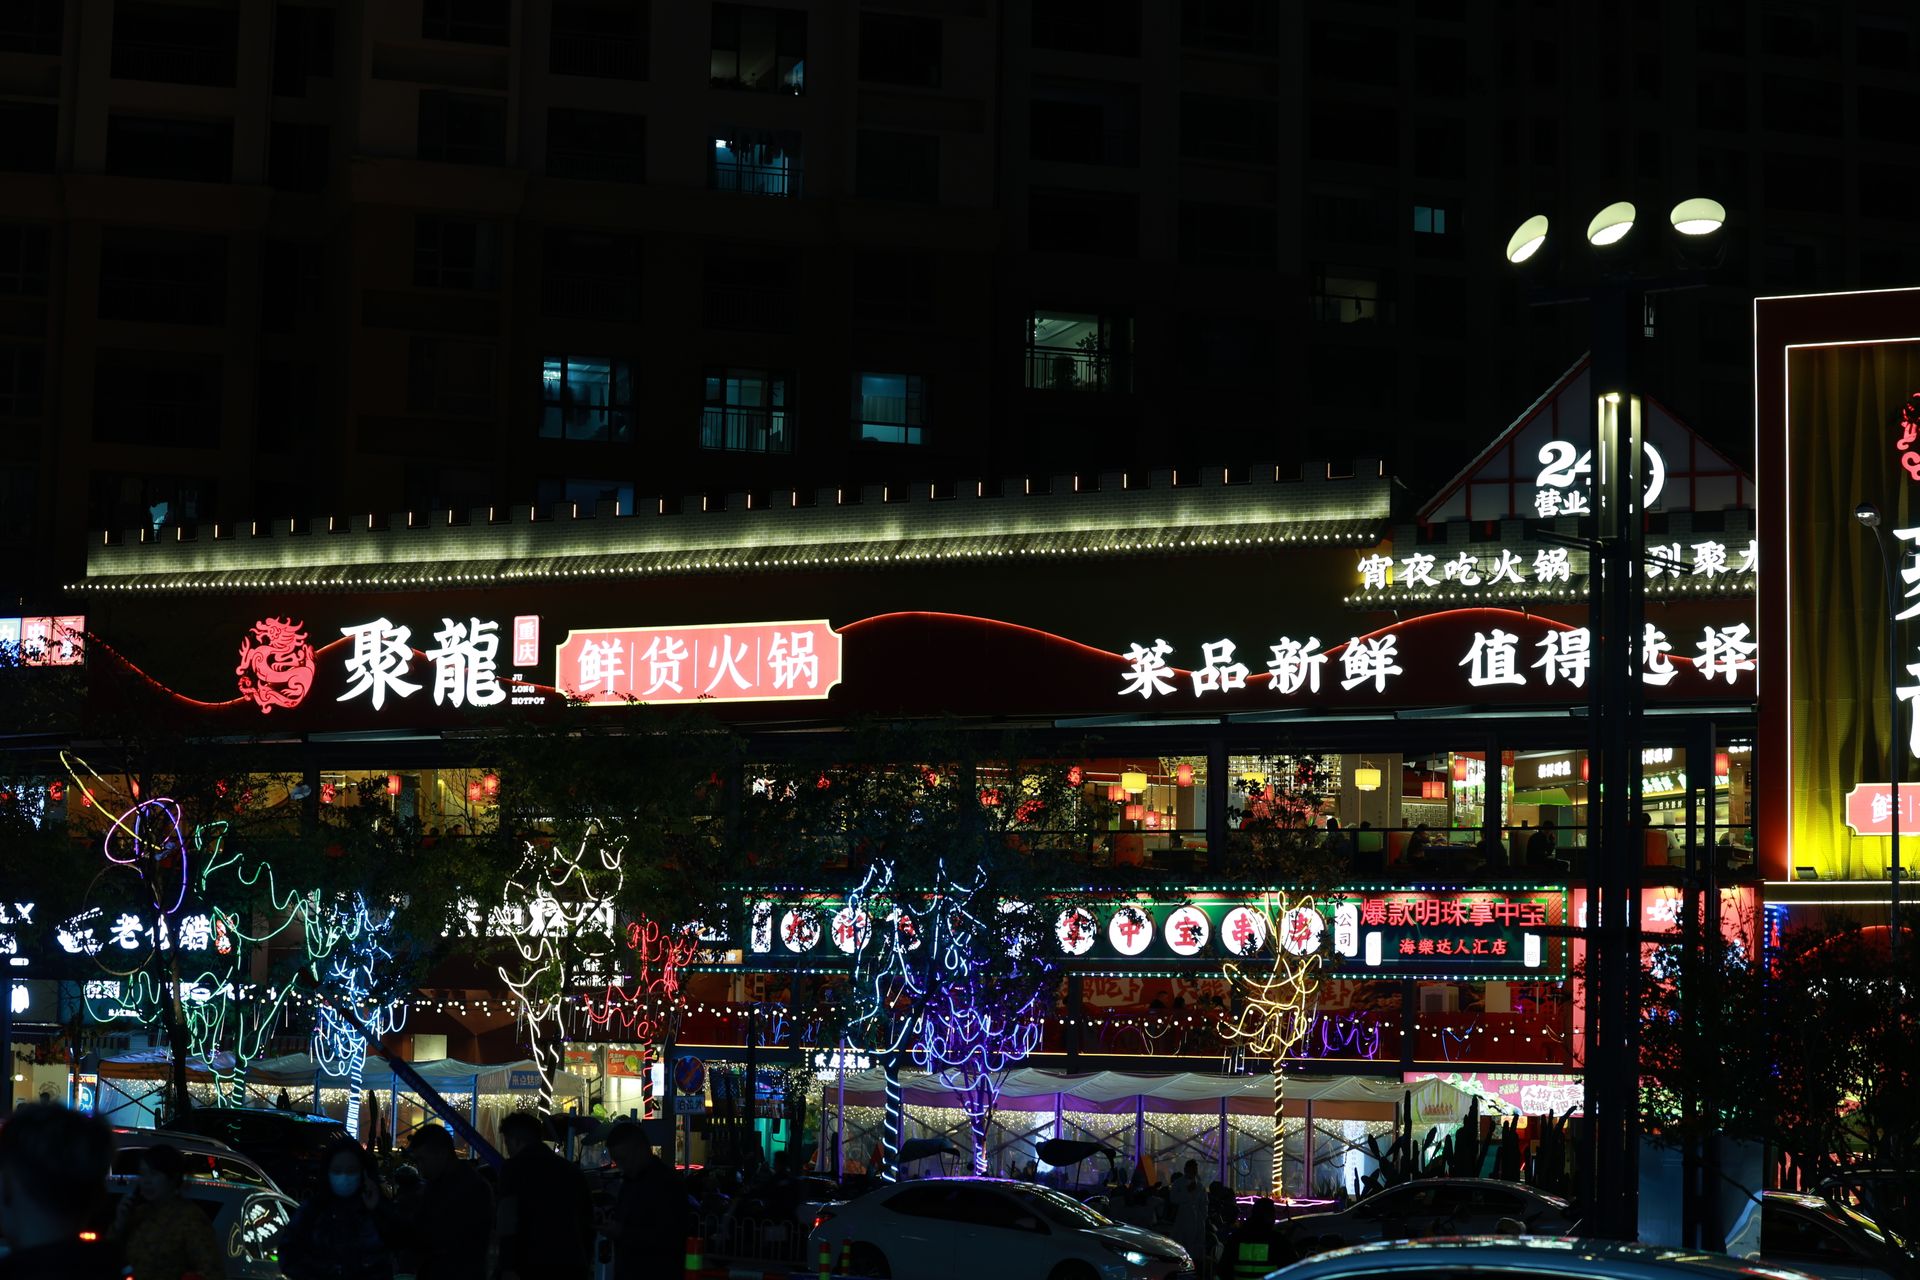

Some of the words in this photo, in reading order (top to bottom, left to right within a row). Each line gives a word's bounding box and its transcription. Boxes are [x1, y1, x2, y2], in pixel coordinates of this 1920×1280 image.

[1357, 548, 1571, 590] 宵夜吃火锅
[519, 621, 535, 661] 重庆
[335, 617, 507, 711] 聚龍
[577, 629, 820, 696] 鲜货火锅
[1118, 634, 1404, 700] 菜品新鲜
[512, 697, 545, 705] HOTPOT
[1338, 911, 1353, 948] 公司
[1360, 897, 1546, 927] 爆款明珠掌中宝
